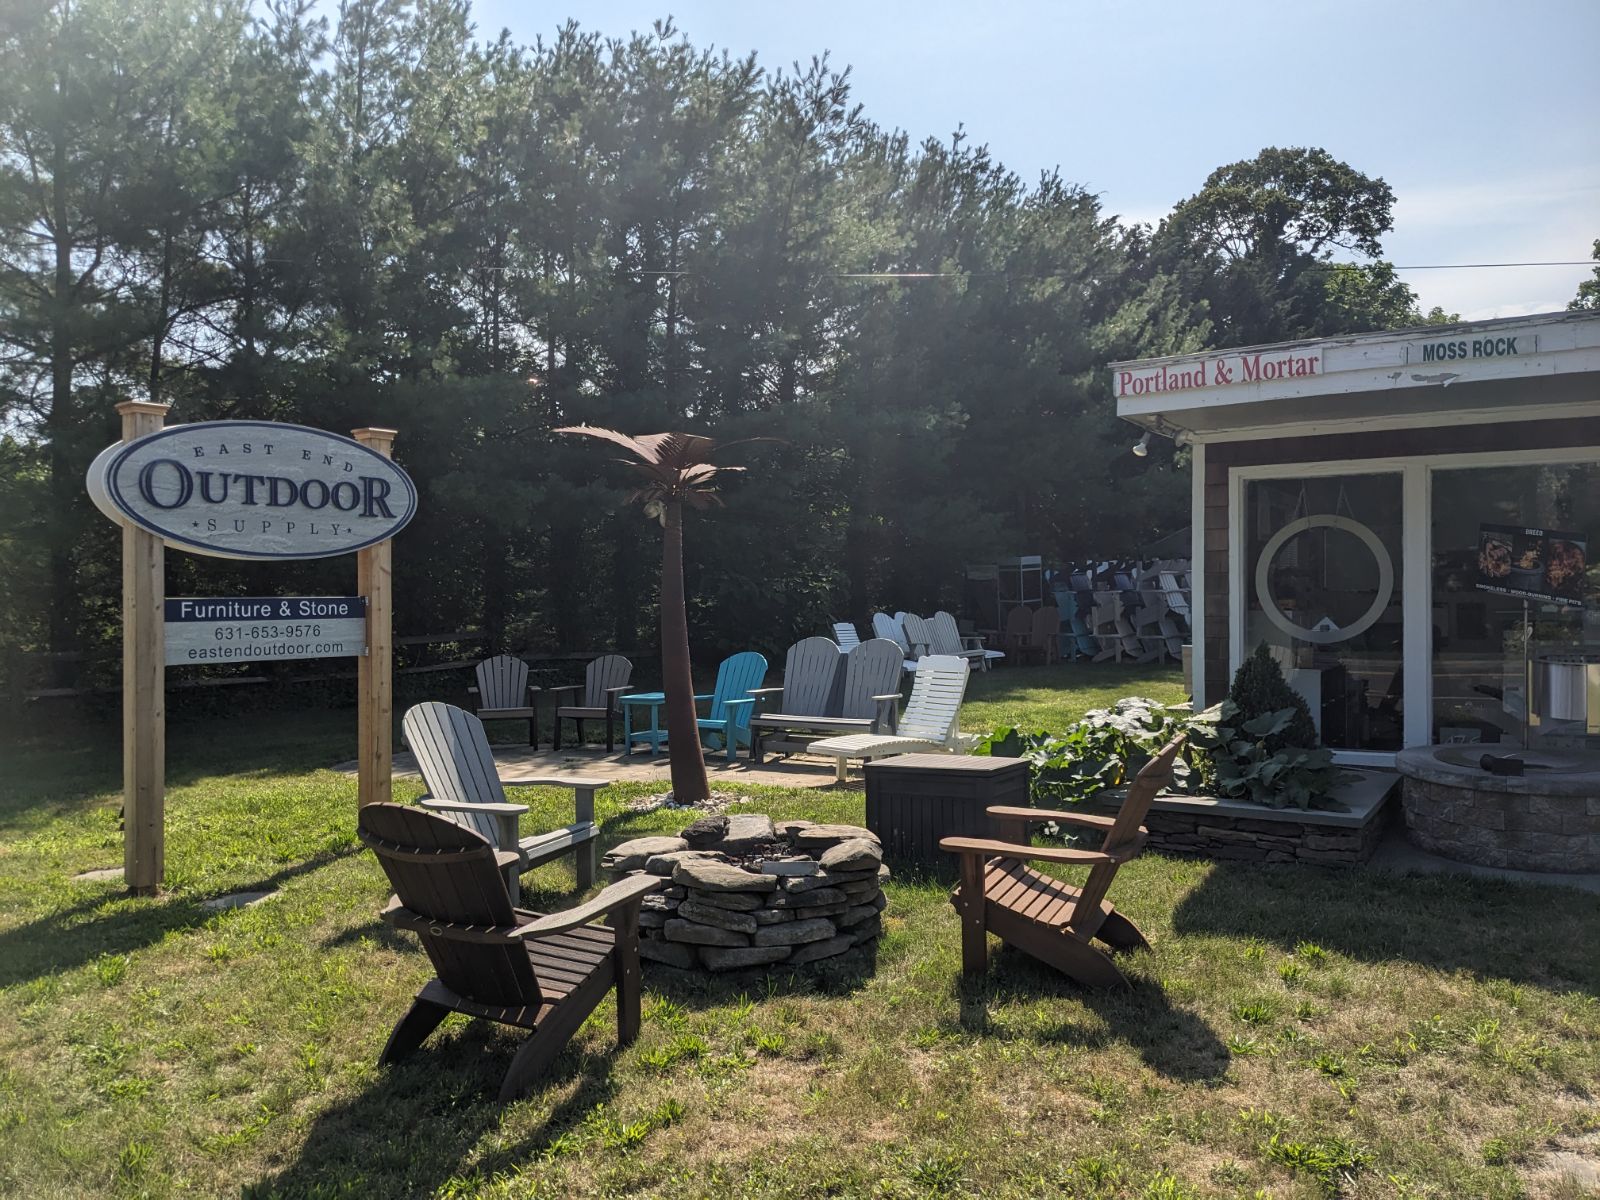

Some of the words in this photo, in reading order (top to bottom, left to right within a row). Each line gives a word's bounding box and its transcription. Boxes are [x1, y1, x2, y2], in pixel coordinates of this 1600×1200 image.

[1423, 341, 1468, 362] MOSS
[1473, 337, 1518, 358] ROCK
[1119, 363, 1206, 396] Portland
[1215, 359, 1233, 385] &
[1241, 354, 1320, 383] Mortar
[193, 443, 273, 457] EAST
[302, 449, 353, 473] END
[139, 458, 397, 518] OUTDOOR
[207, 519, 340, 536] SUPPLY
[181, 602, 271, 618] Furniture
[279, 602, 292, 616] &
[299, 601, 349, 616] Stone
[215, 625, 321, 641] 631-653-9576
[188, 640, 343, 660] eastendoutdoor.com
